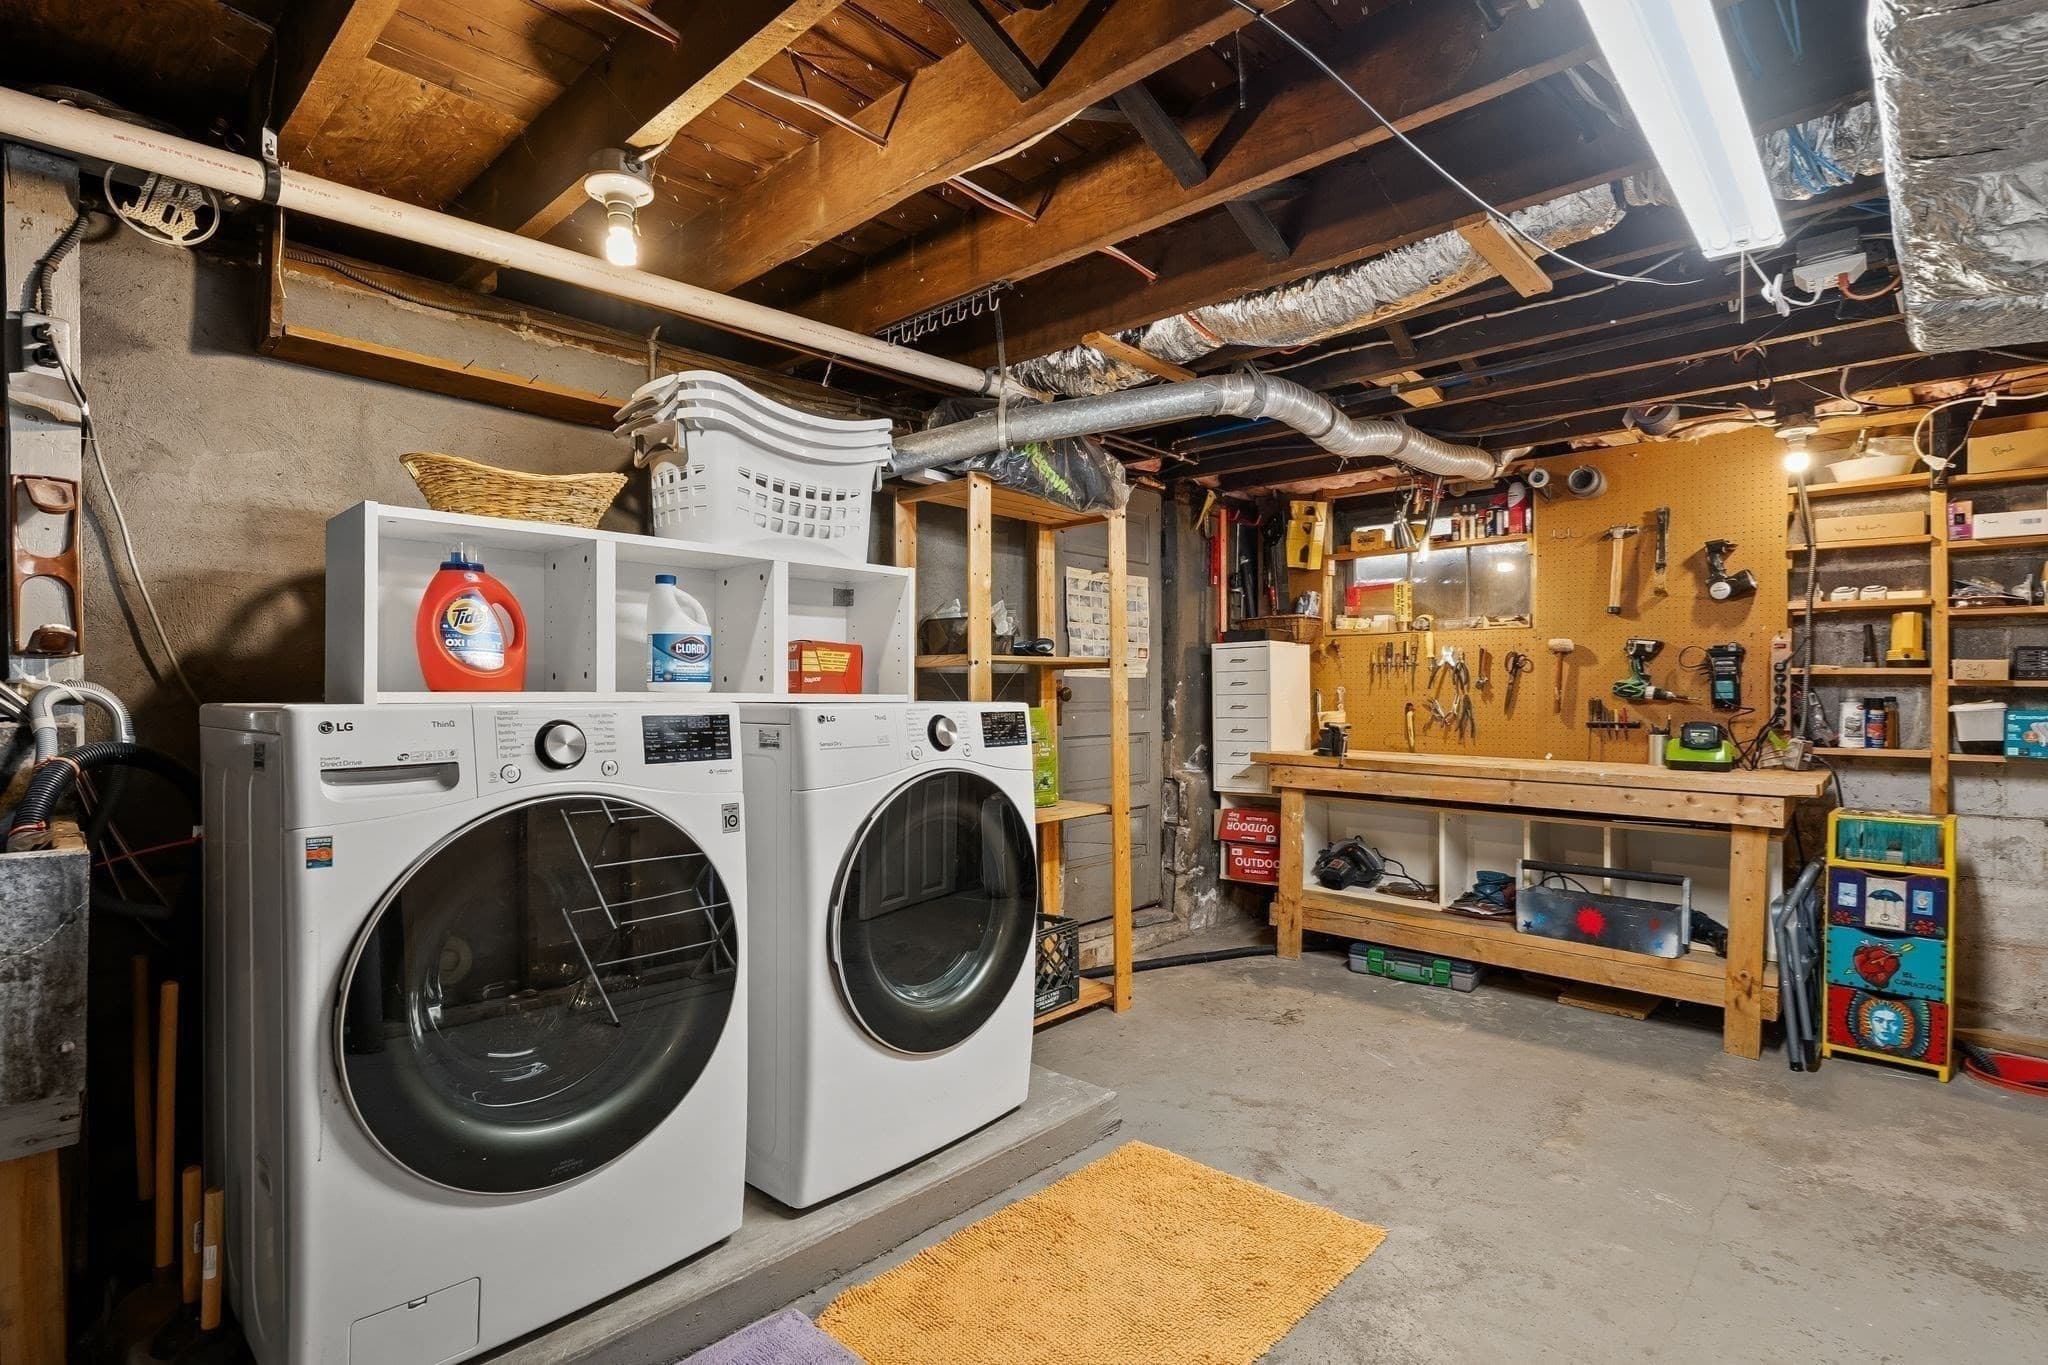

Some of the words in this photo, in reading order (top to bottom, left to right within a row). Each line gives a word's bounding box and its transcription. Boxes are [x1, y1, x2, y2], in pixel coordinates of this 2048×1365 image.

[452, 608, 483, 628] Tide
[445, 638, 465, 647] OXI
[675, 643, 706, 654] CLOROX
[431, 720, 455, 728] ThinQ
[826, 715, 836, 723] LG
[337, 722, 354, 732] LG
[1226, 821, 1275, 834] OUTDOOR
[1235, 857, 1280, 868] OUTDOO
